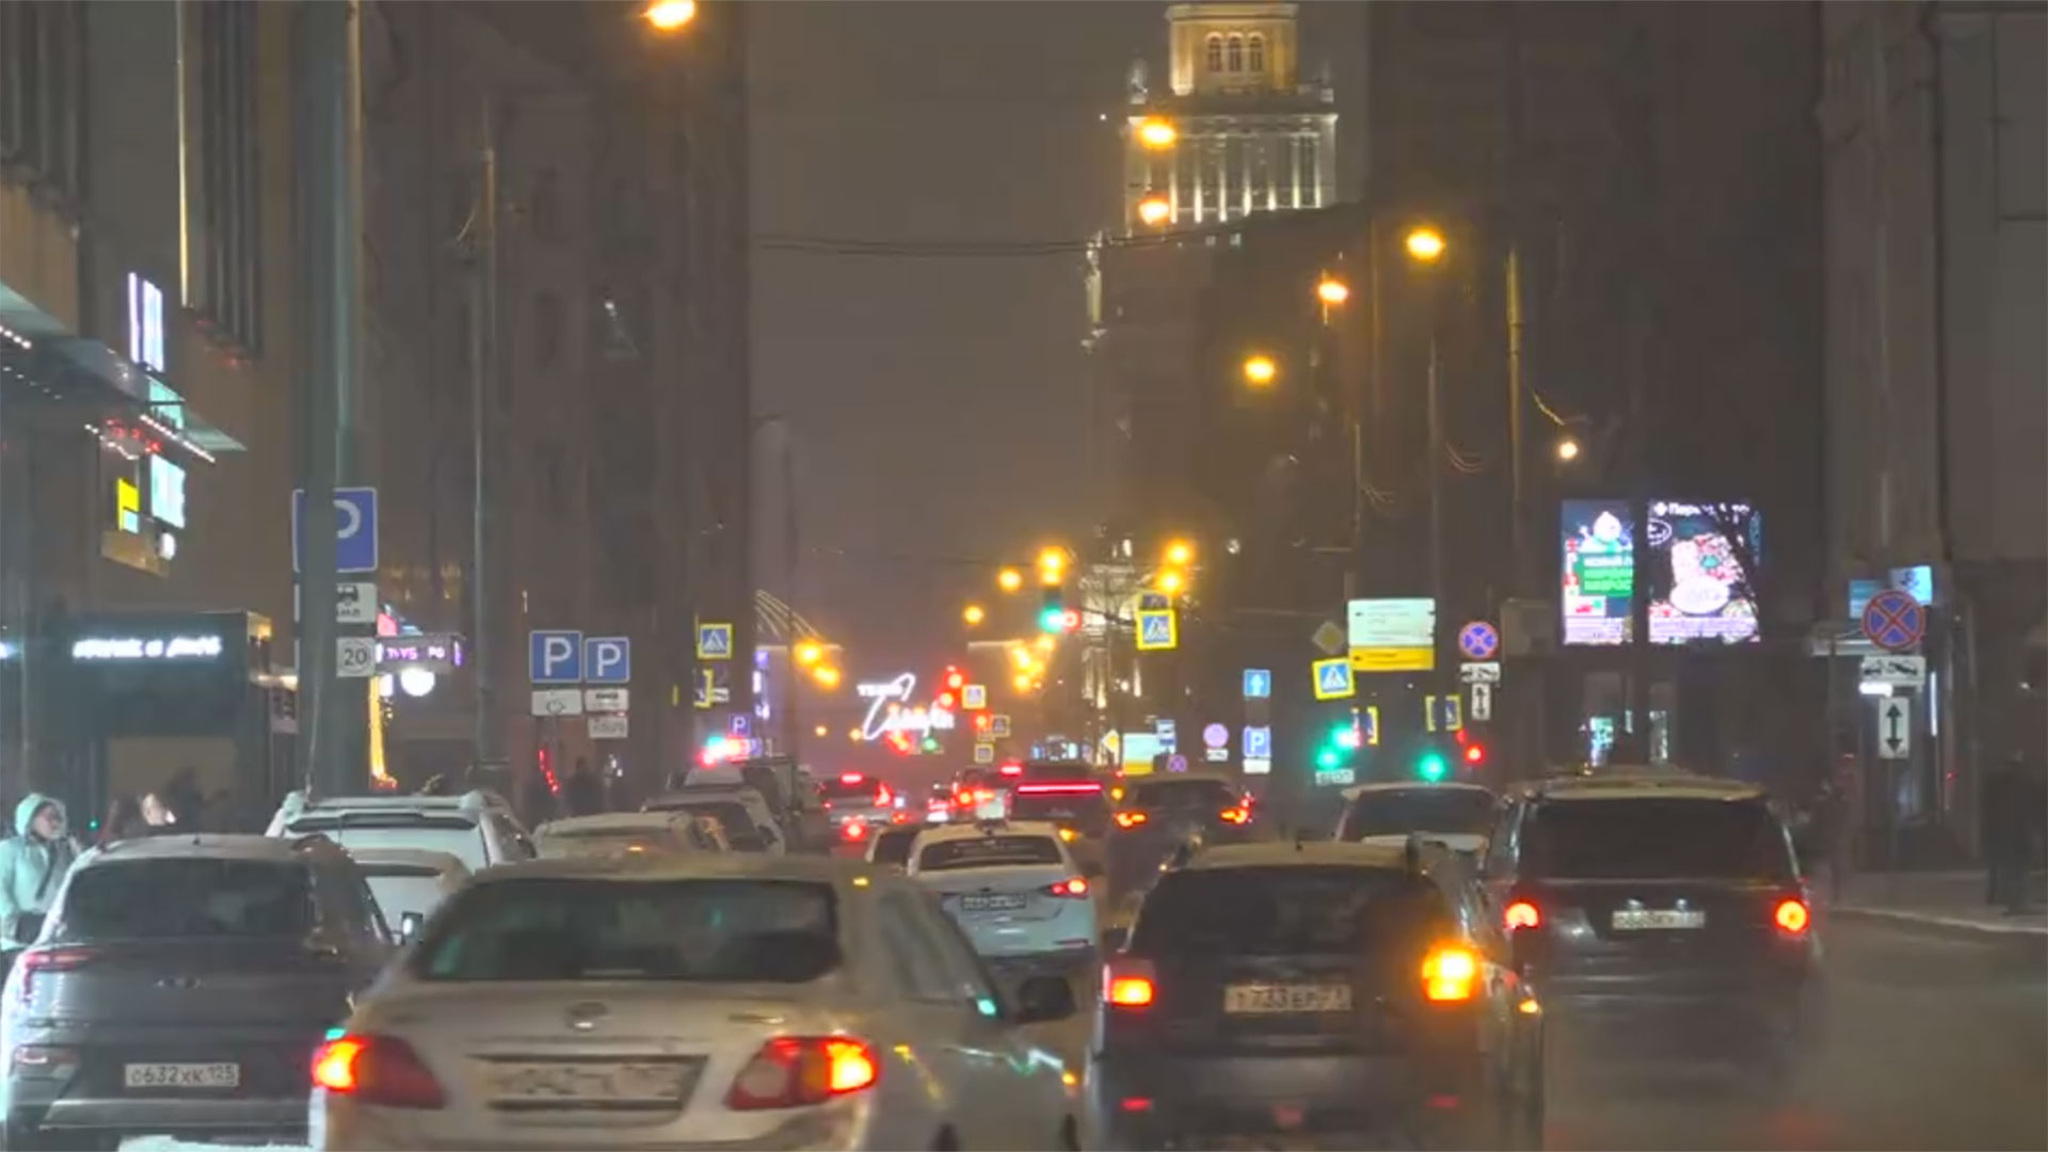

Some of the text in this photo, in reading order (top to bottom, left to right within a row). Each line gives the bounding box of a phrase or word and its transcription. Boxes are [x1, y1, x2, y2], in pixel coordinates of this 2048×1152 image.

[344, 648, 367, 666] 20
[544, 637, 572, 677] P
[597, 643, 621, 677] P
